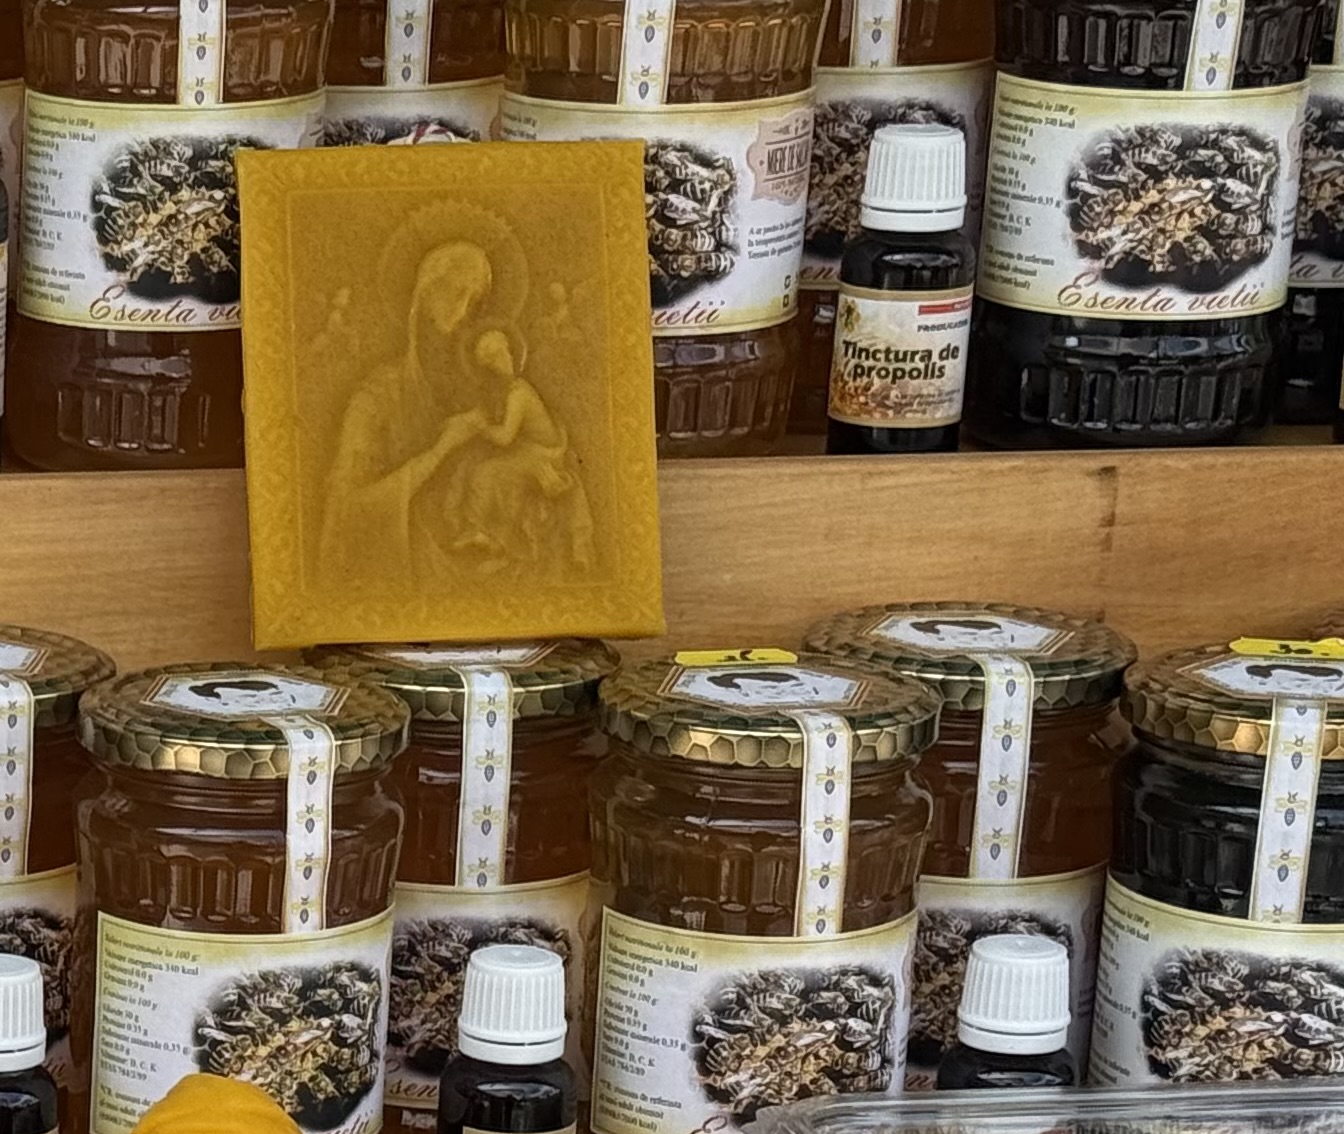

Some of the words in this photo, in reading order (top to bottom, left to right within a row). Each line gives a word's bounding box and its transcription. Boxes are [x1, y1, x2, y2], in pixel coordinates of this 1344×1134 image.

[89, 286, 198, 322] Esenta
[1057, 271, 1175, 313] Esenta
[651, 301, 726, 327] ietii
[842, 340, 933, 362] Tinctura
[939, 343, 960, 361] de
[853, 362, 946, 385] propolis
